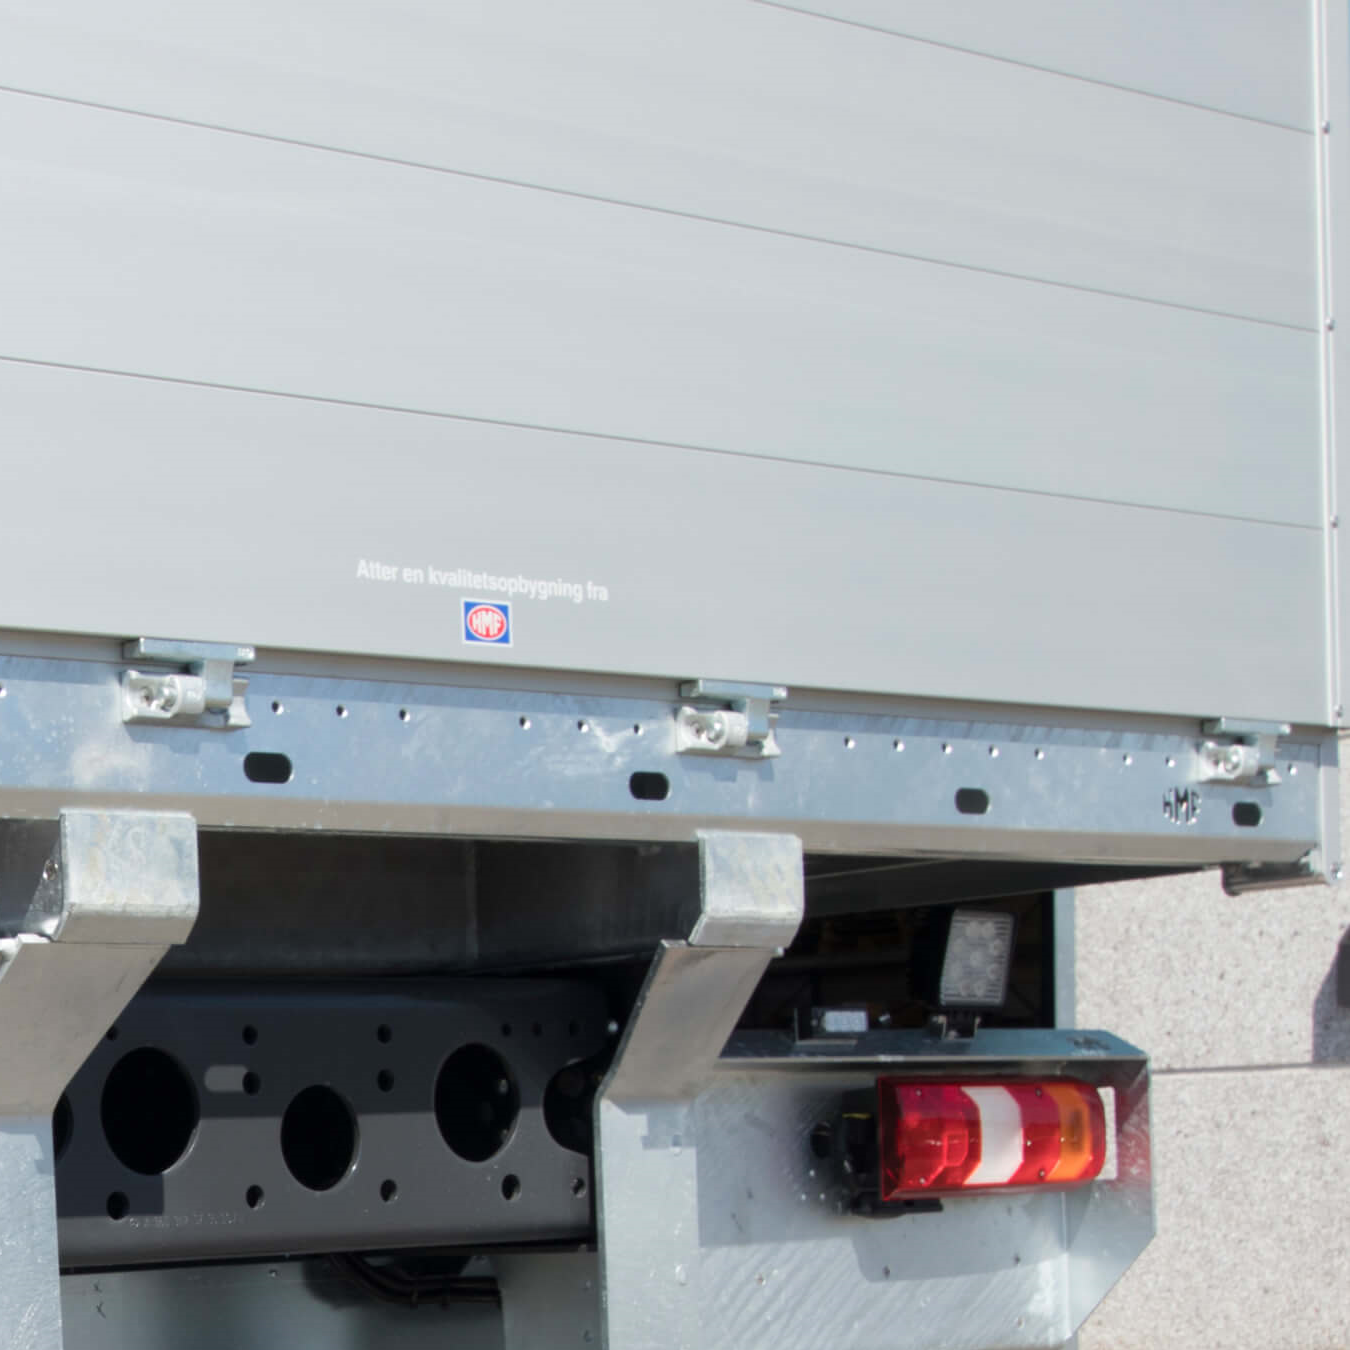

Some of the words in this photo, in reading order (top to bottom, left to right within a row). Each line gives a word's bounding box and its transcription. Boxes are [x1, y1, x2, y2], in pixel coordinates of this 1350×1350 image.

[402, 567, 424, 584] en
[428, 565, 583, 603] kvalitetsopbygning
[587, 581, 609, 602] fra
[472, 610, 502, 637] HMF
[1162, 787, 1201, 825] HMF
